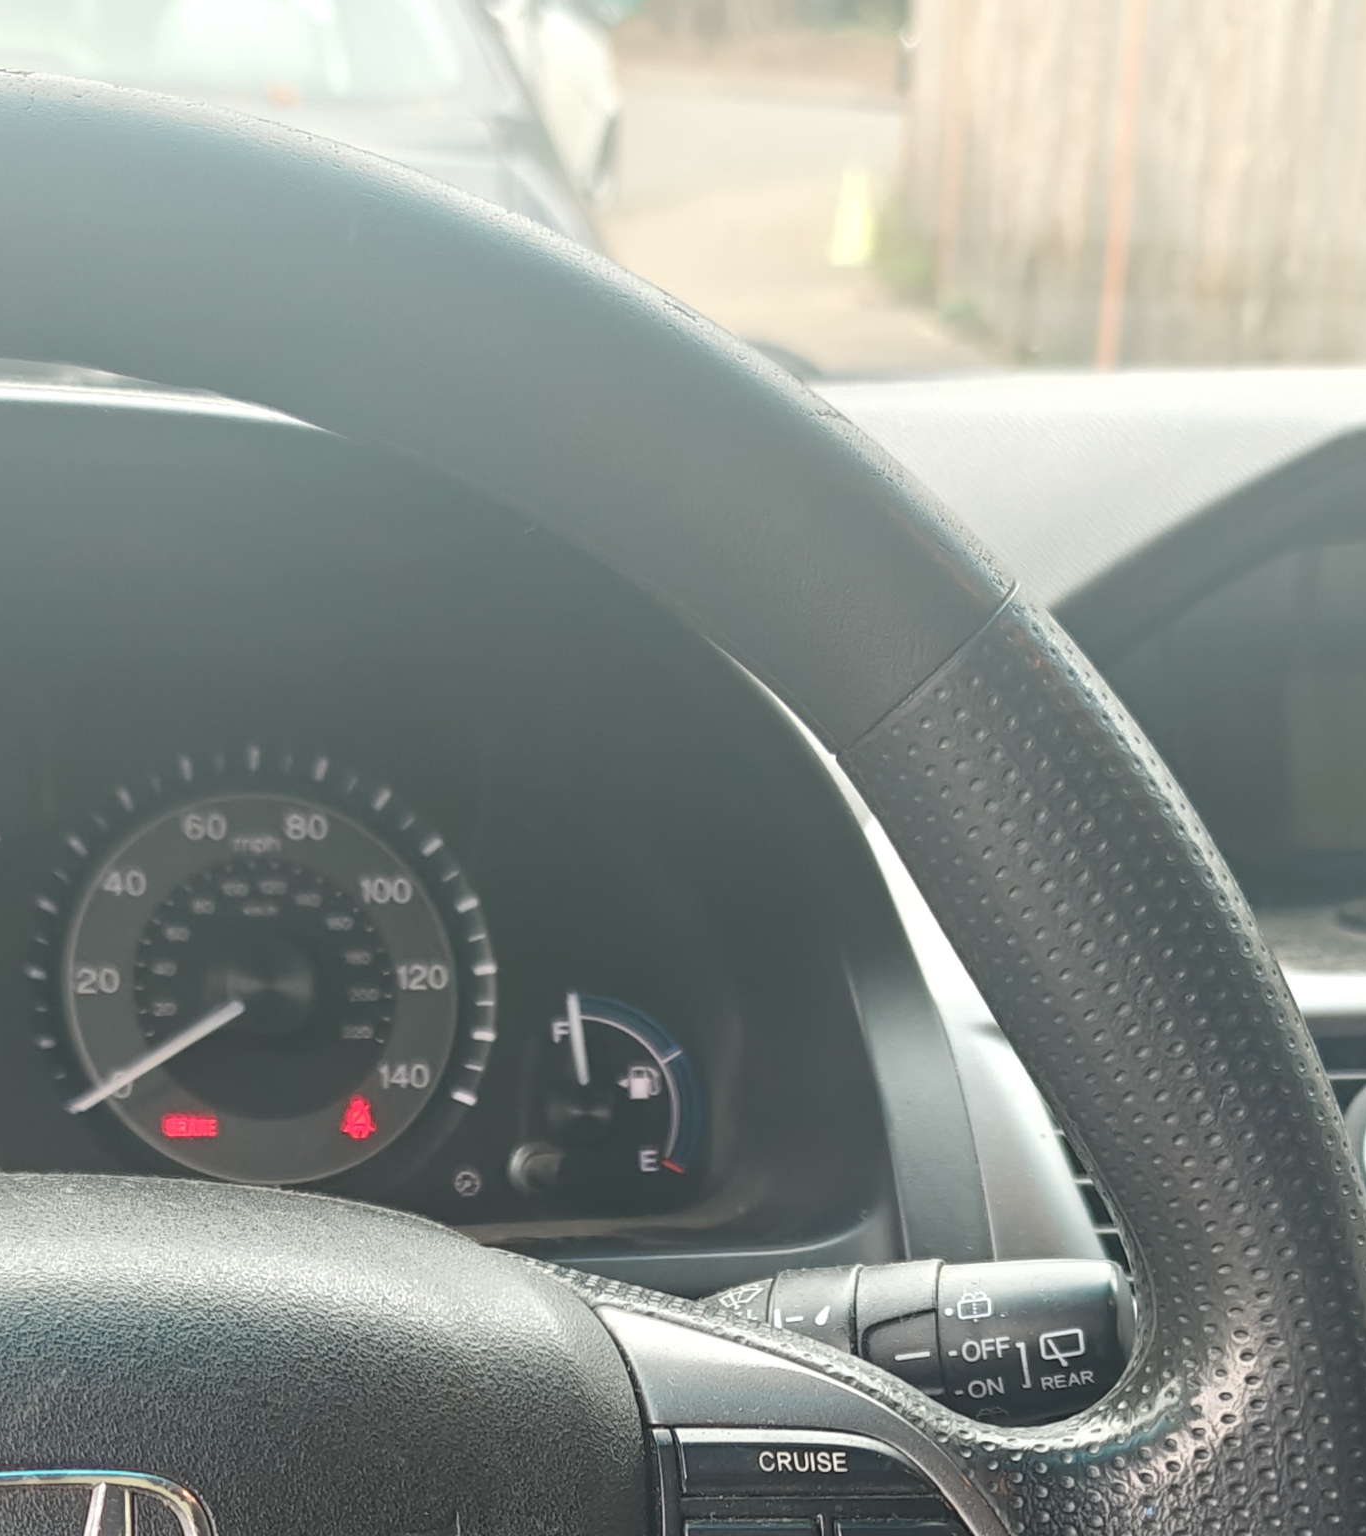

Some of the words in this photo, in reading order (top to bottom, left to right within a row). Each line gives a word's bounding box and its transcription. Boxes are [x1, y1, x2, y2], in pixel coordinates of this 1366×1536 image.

[182, 814, 226, 840] 60
[285, 814, 328, 841] 80
[102, 870, 146, 897] 40
[360, 877, 412, 904] 100
[76, 968, 120, 994] 20
[396, 964, 448, 991] 120
[552, 1021, 570, 1044] F
[378, 1063, 429, 1090] 140
[641, 1150, 659, 1171] E
[961, 1336, 1011, 1364] OFF
[967, 1376, 1005, 1399] ON
[1040, 1369, 1095, 1391] REAR
[758, 1451, 848, 1474] CRUISE
